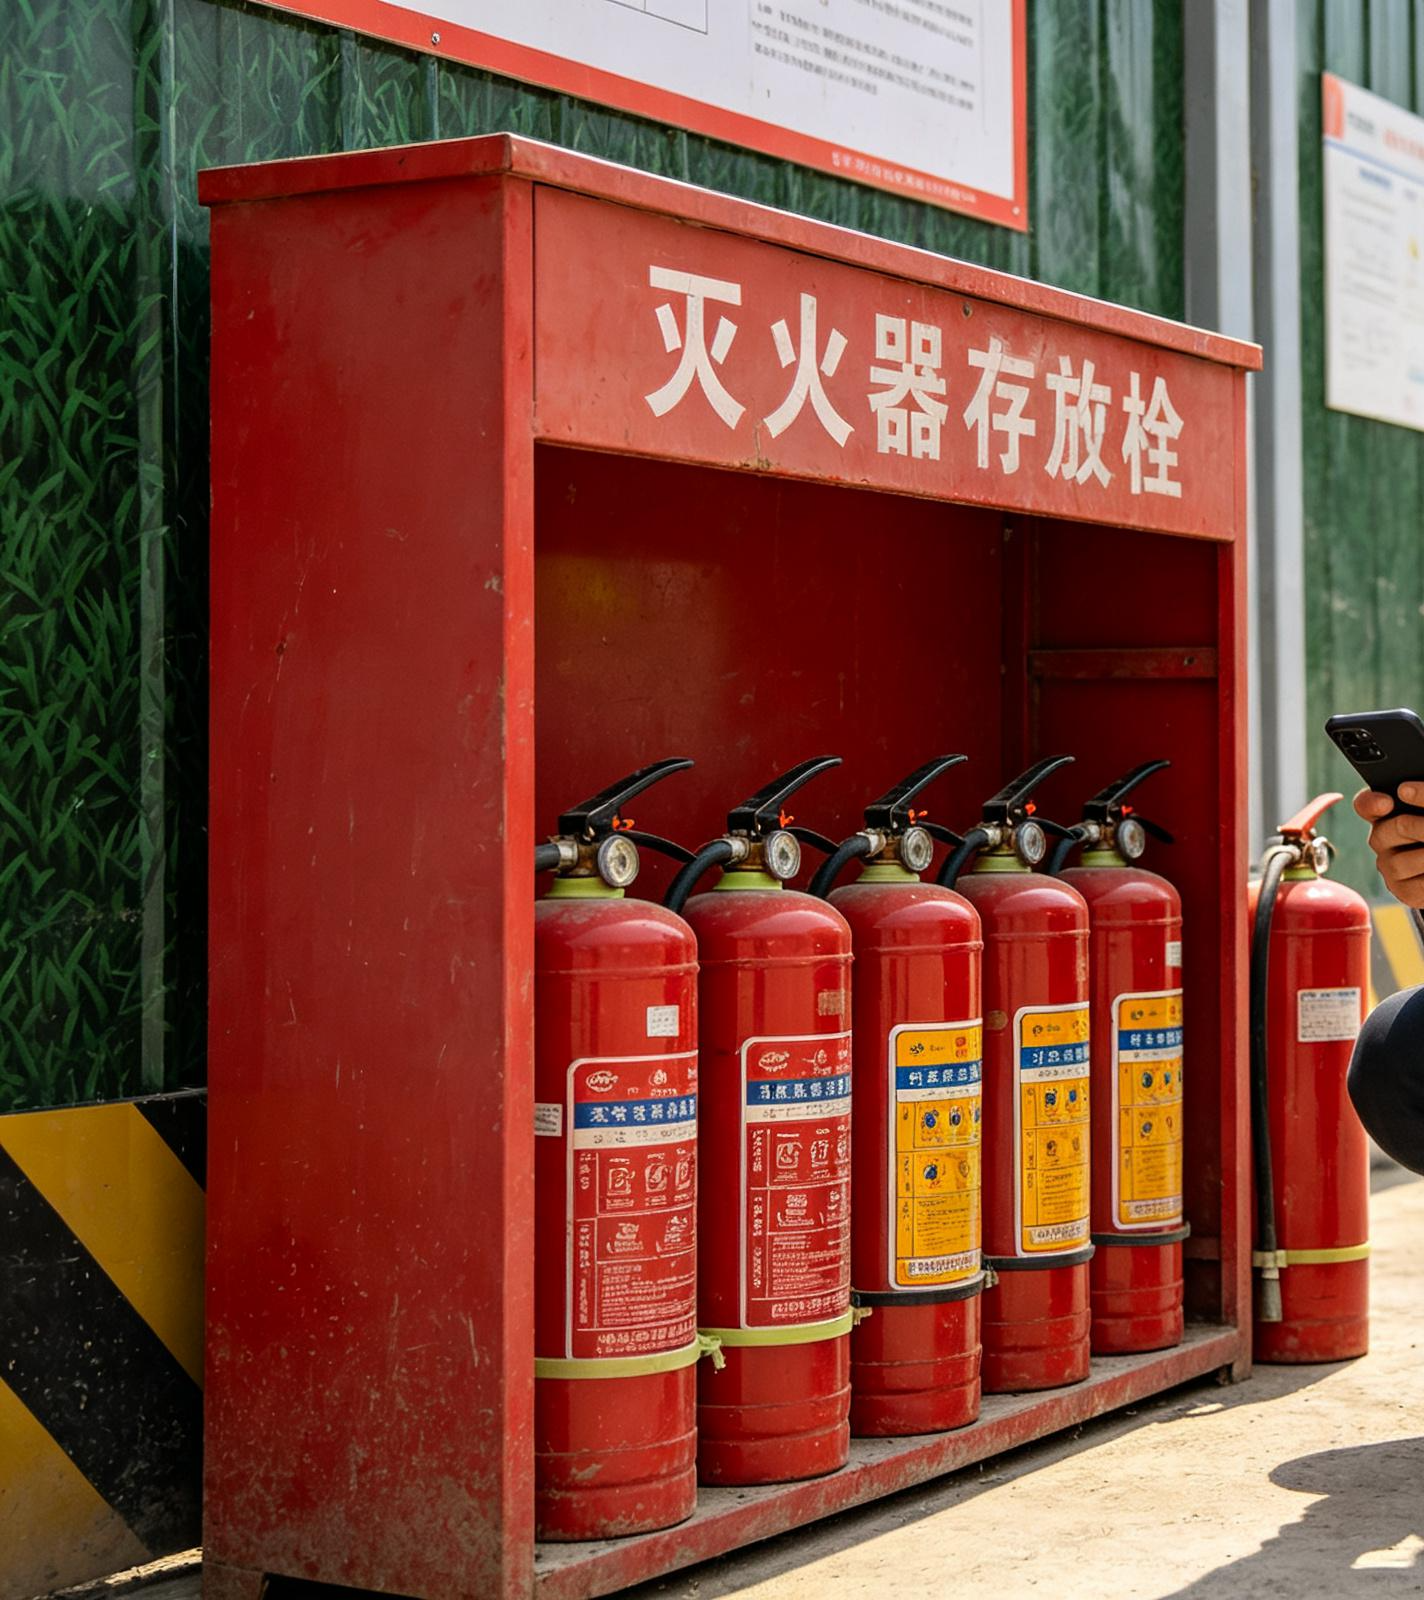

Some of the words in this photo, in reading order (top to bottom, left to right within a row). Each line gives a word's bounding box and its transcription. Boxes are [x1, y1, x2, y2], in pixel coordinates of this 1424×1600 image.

[644, 265, 1184, 498] 灭火器存放栓
